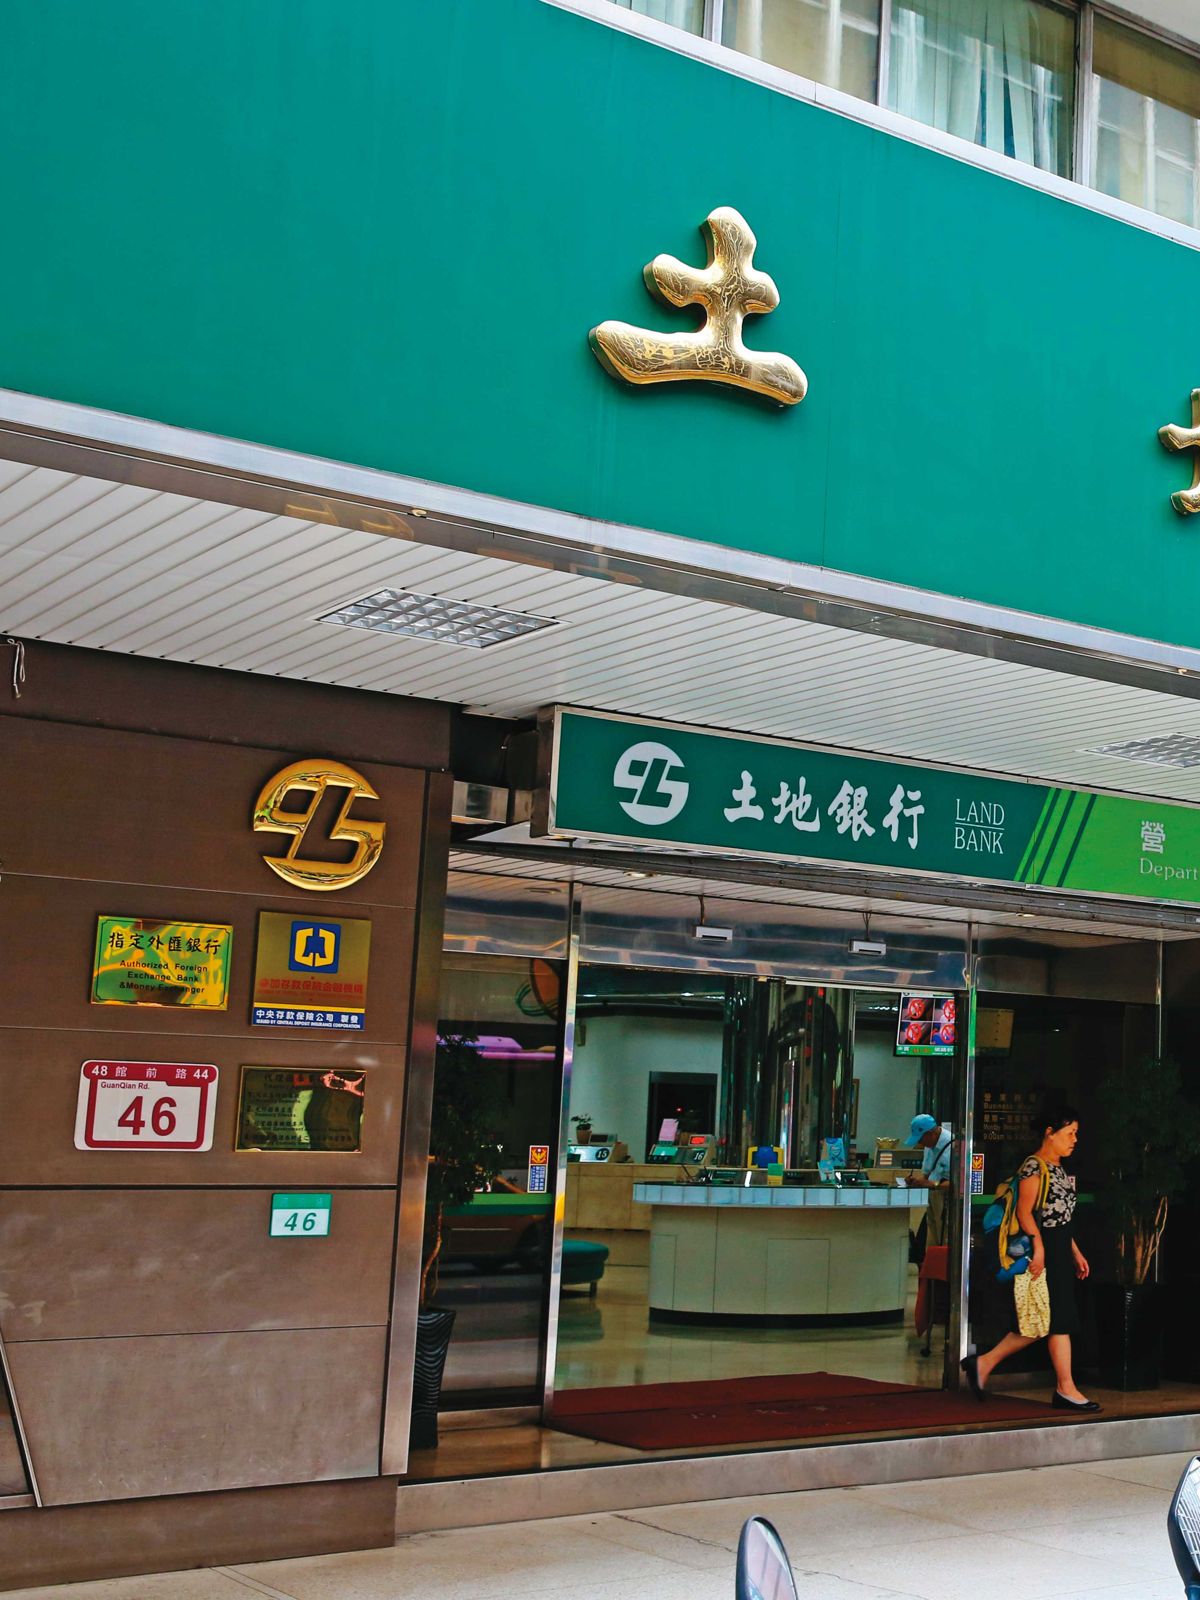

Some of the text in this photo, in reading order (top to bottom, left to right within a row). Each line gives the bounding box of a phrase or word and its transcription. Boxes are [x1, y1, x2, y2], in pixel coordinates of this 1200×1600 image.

[723, 770, 925, 850] 土地銀行
[956, 798, 1005, 826] LAND
[954, 826, 1004, 855] BANK
[109, 931, 221, 955] 指定外匯銀行
[119, 960, 208, 973] Authorized Foreign
[127, 971, 199, 982] Exchange Bank
[119, 981, 154, 992] &Money
[91, 1065, 209, 1080] 48 館前路 44
[100, 1081, 150, 1090] GuanQian Rd.
[117, 1095, 178, 1136] 46
[284, 1212, 317, 1231] 46
